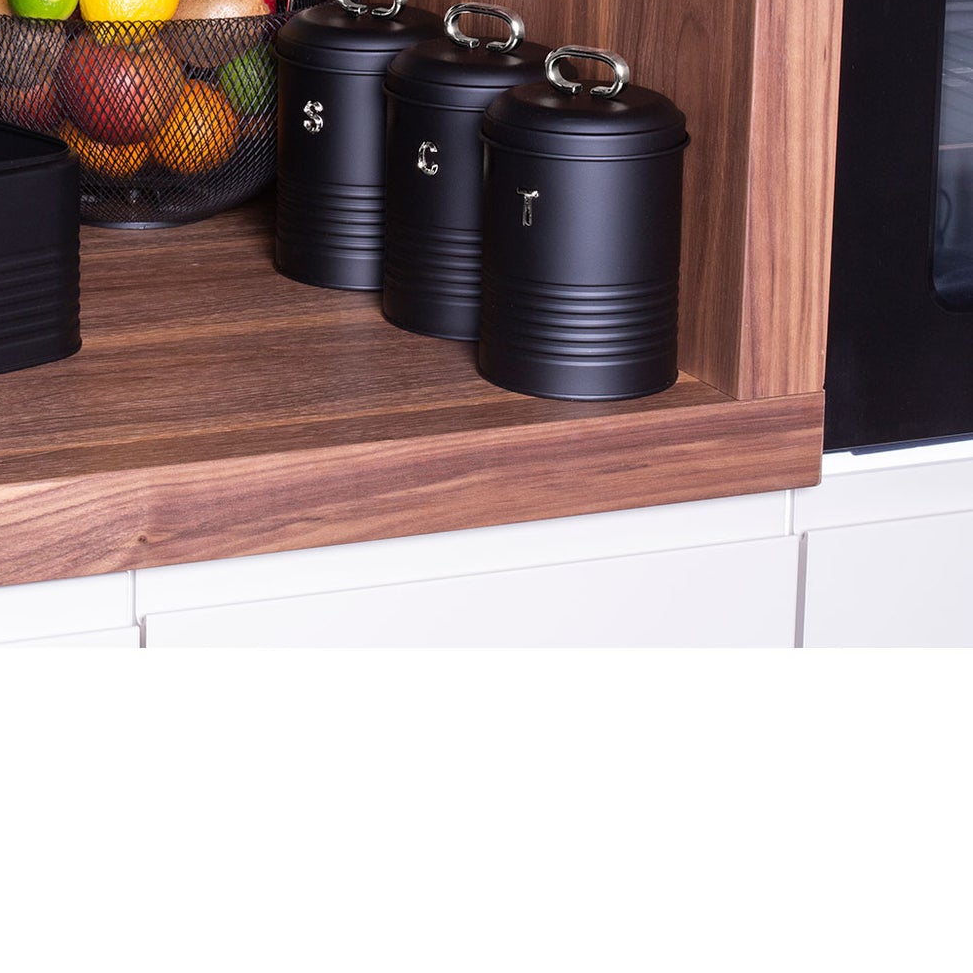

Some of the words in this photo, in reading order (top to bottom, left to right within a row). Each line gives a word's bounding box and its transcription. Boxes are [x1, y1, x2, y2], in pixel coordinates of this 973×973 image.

[303, 100, 324, 133] S
[418, 141, 439, 176] C
[516, 187, 539, 226] T
